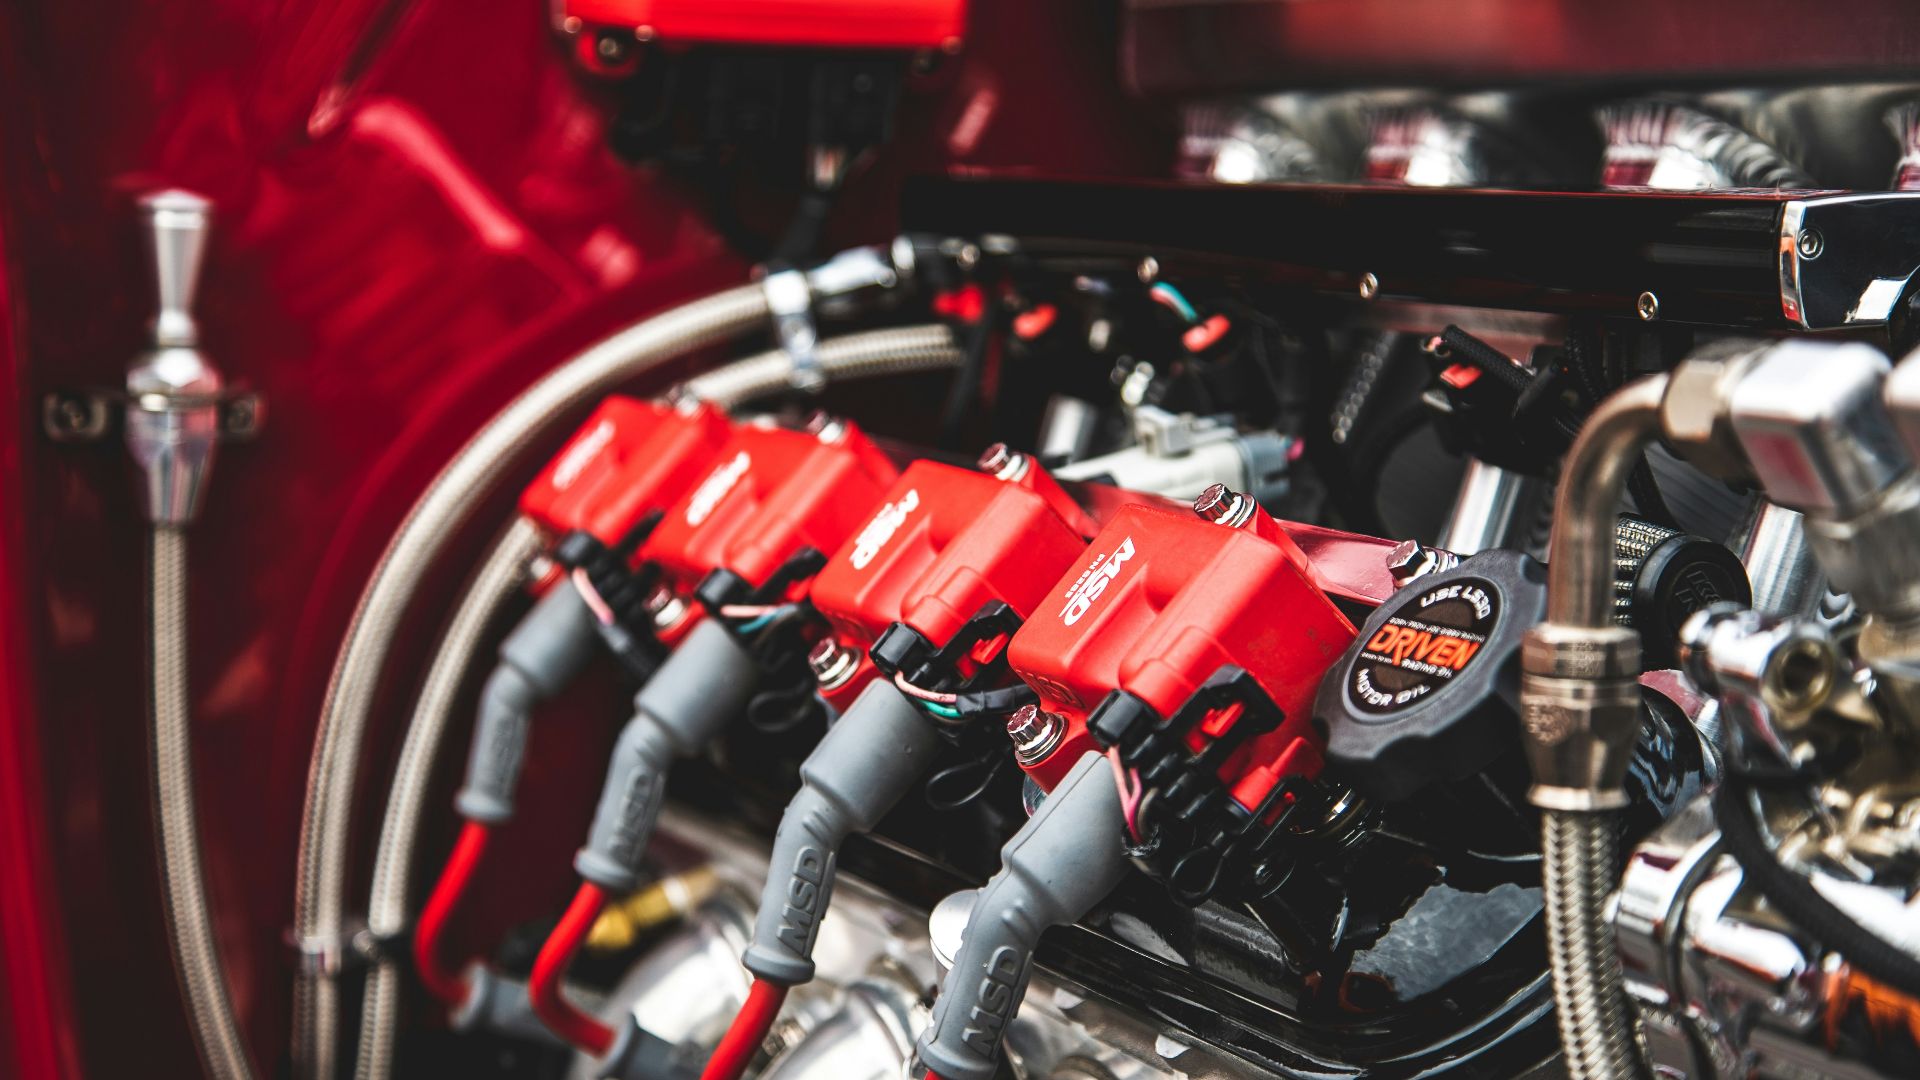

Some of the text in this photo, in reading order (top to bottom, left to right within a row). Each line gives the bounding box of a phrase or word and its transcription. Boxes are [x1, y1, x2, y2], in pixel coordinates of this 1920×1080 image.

[852, 488, 920, 571] MSD
[1062, 537, 1136, 627] MSD
[1421, 585, 1463, 608] USE
[1356, 668, 1431, 706] MOTOR OIL
[1366, 624, 1480, 671] DRIVEN
[776, 847, 828, 952] MSD
[961, 945, 1023, 1057] MSD
